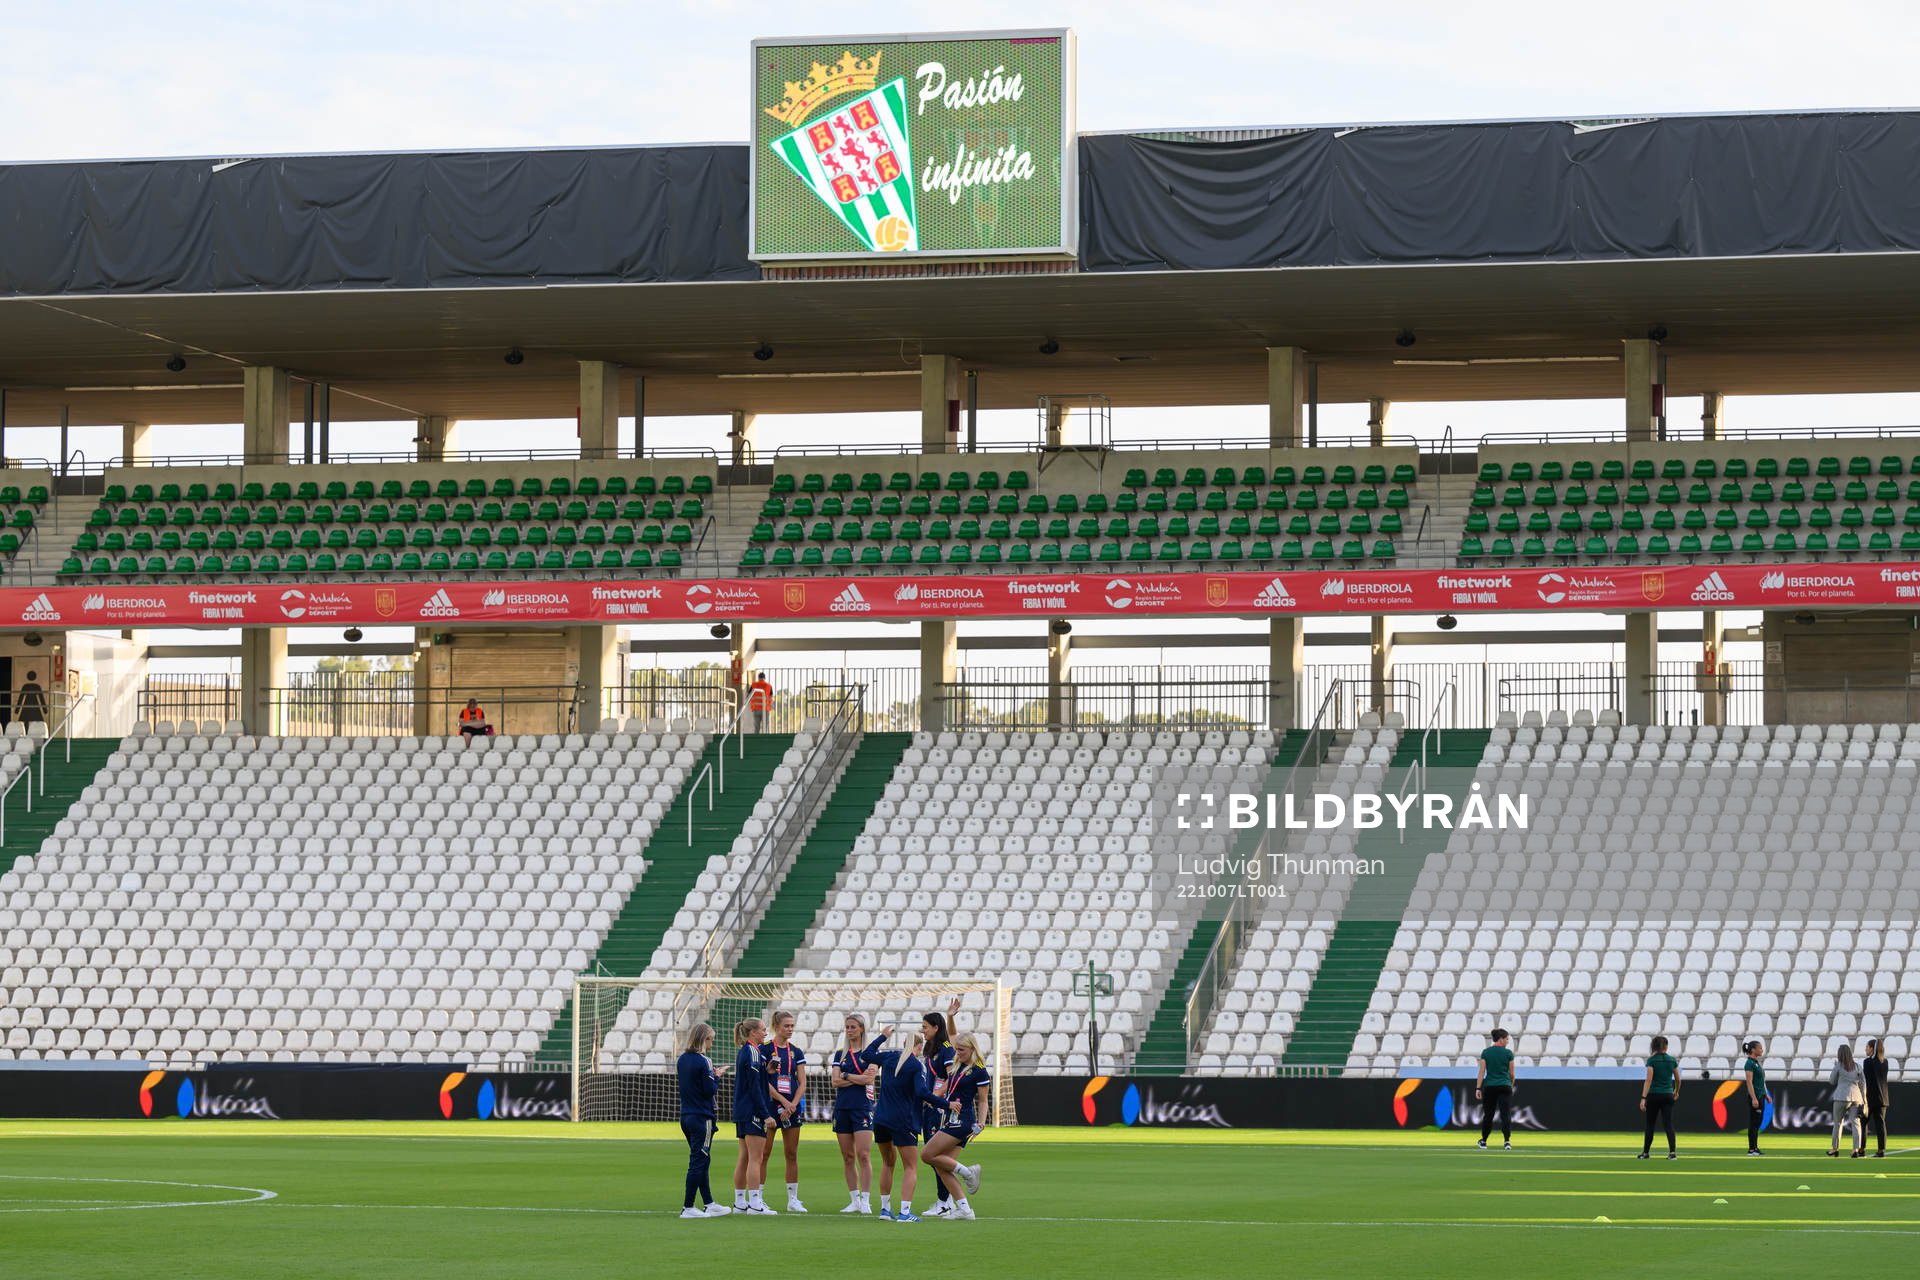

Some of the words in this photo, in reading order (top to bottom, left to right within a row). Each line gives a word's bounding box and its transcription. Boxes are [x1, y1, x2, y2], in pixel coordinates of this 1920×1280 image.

[915, 61, 1025, 115] Pasión
[921, 143, 1036, 205] infinita
[1880, 568, 1920, 582] finet
[1008, 580, 1080, 594] finetwork
[1437, 575, 1512, 588] finetwork
[1787, 576, 1856, 588] IBERDROLA
[592, 586, 662, 600] finetwork
[920, 588, 984, 598] IBERDROLA
[1347, 584, 1413, 594] IBERDROLA
[1690, 589, 1735, 600] adidas
[1896, 586, 1916, 598] FIBRA
[106, 598, 167, 609] IBERDROLA
[188, 591, 257, 604] finetwork
[507, 594, 570, 604] IBERDROLA
[1253, 595, 1296, 607] adidas
[420, 606, 460, 616] adidas
[829, 600, 872, 612] adidas
[22, 610, 61, 621] adidas
